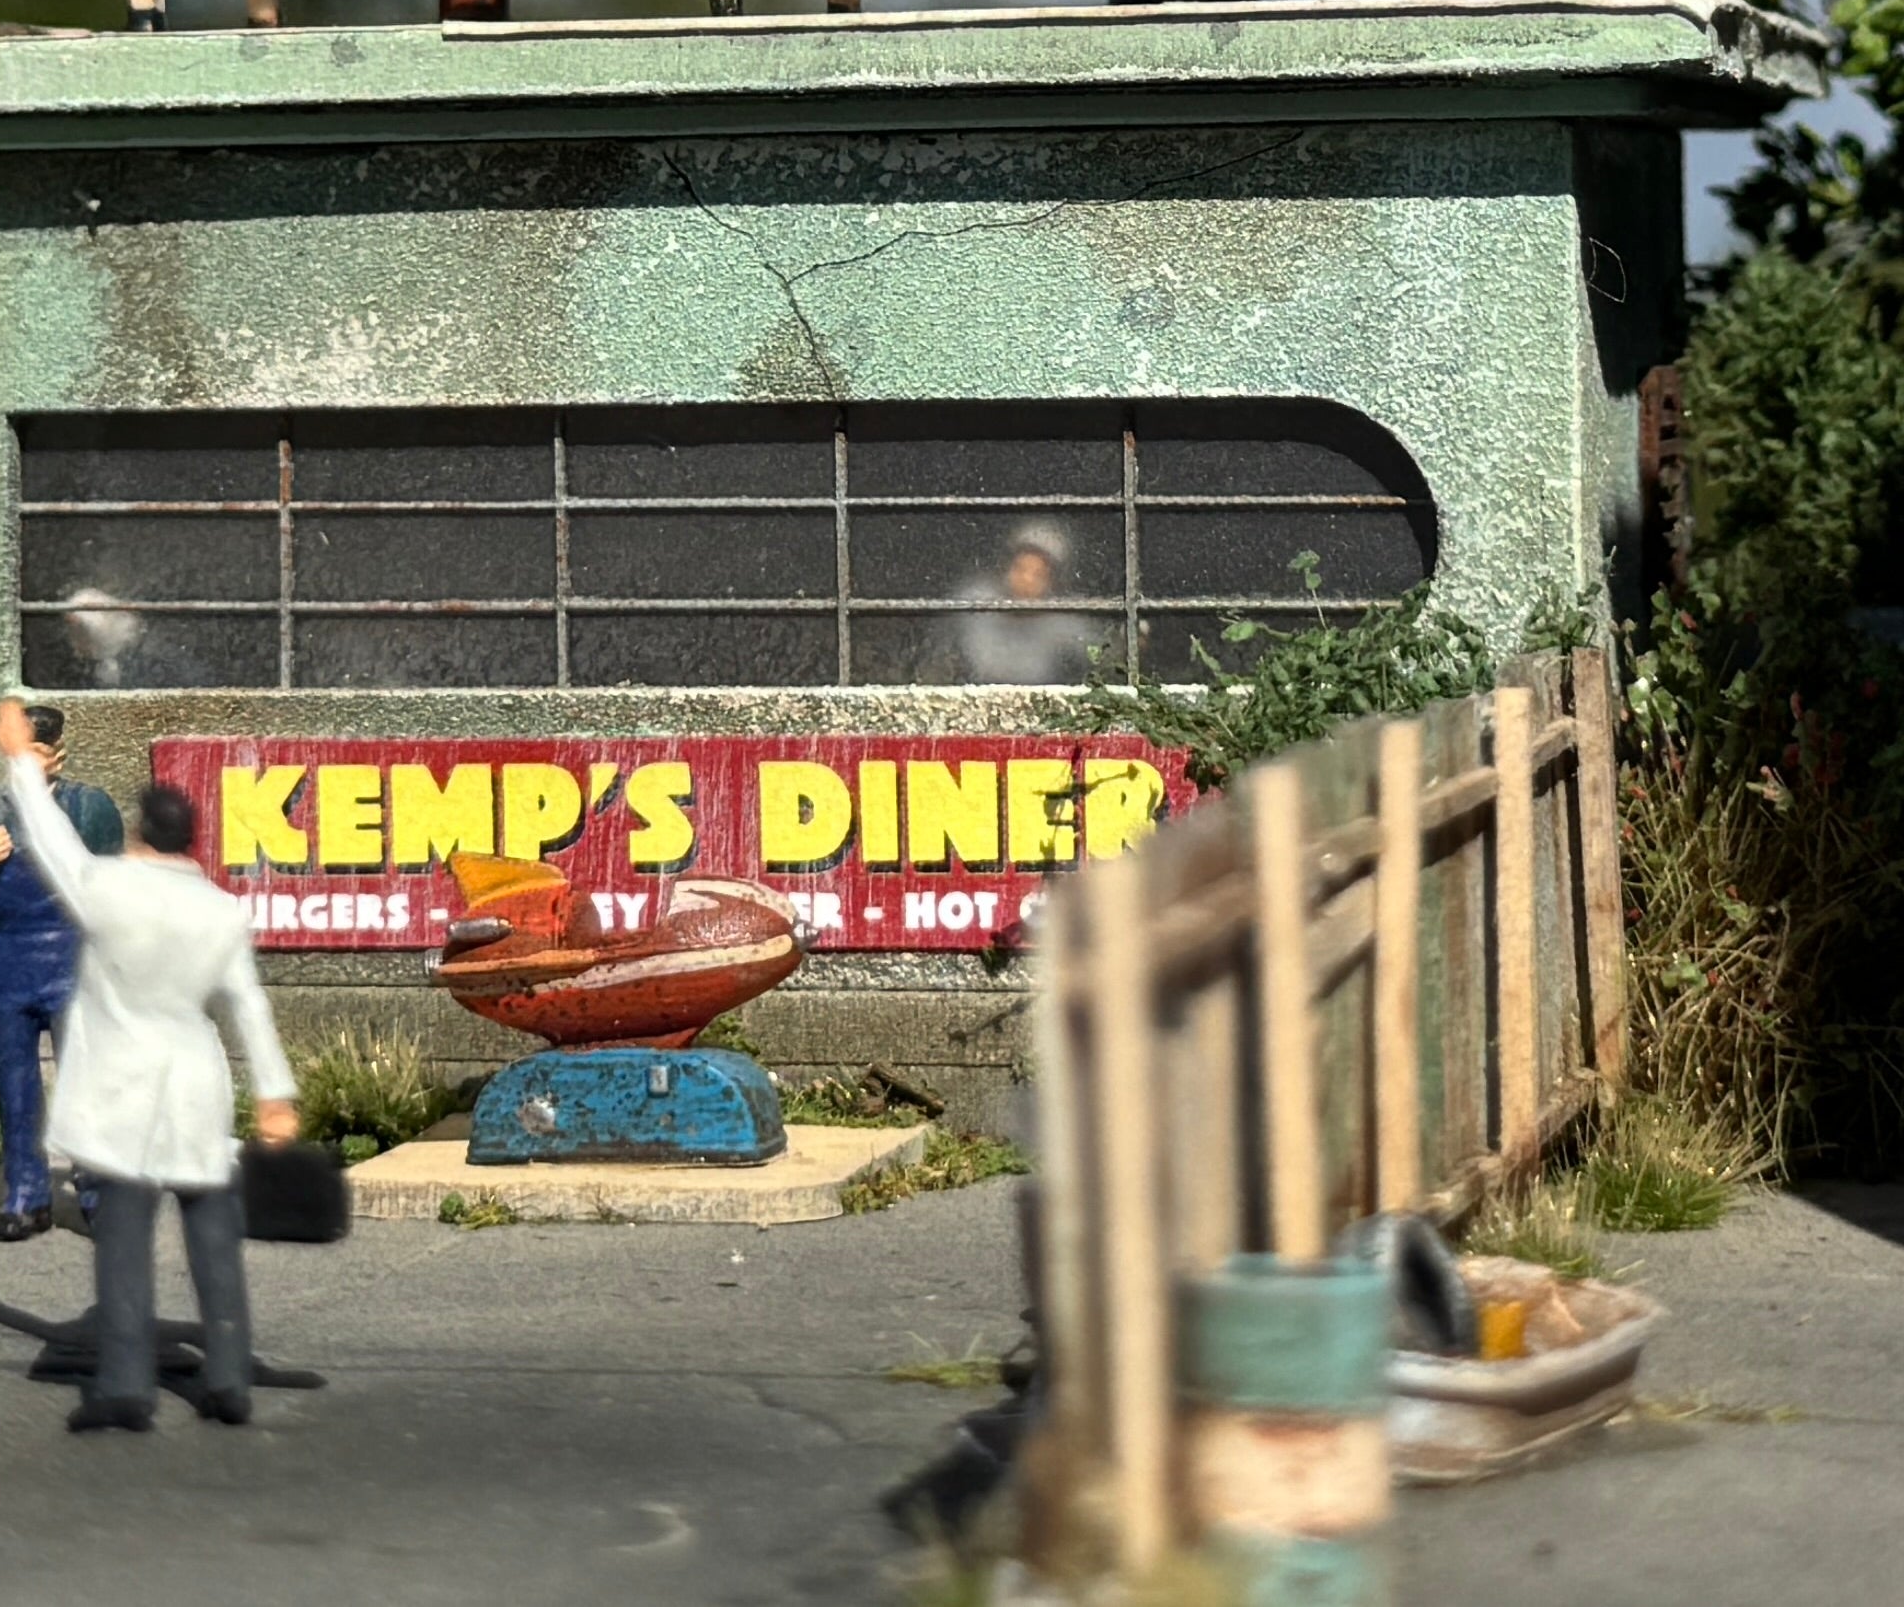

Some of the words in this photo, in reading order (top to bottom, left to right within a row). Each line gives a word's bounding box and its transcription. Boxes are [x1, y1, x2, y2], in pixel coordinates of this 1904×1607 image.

[220, 761, 698, 874] KEMP'S
[758, 757, 1169, 874] DINER
[238, 892, 411, 930] URGERS
[904, 890, 999, 931] HOT
